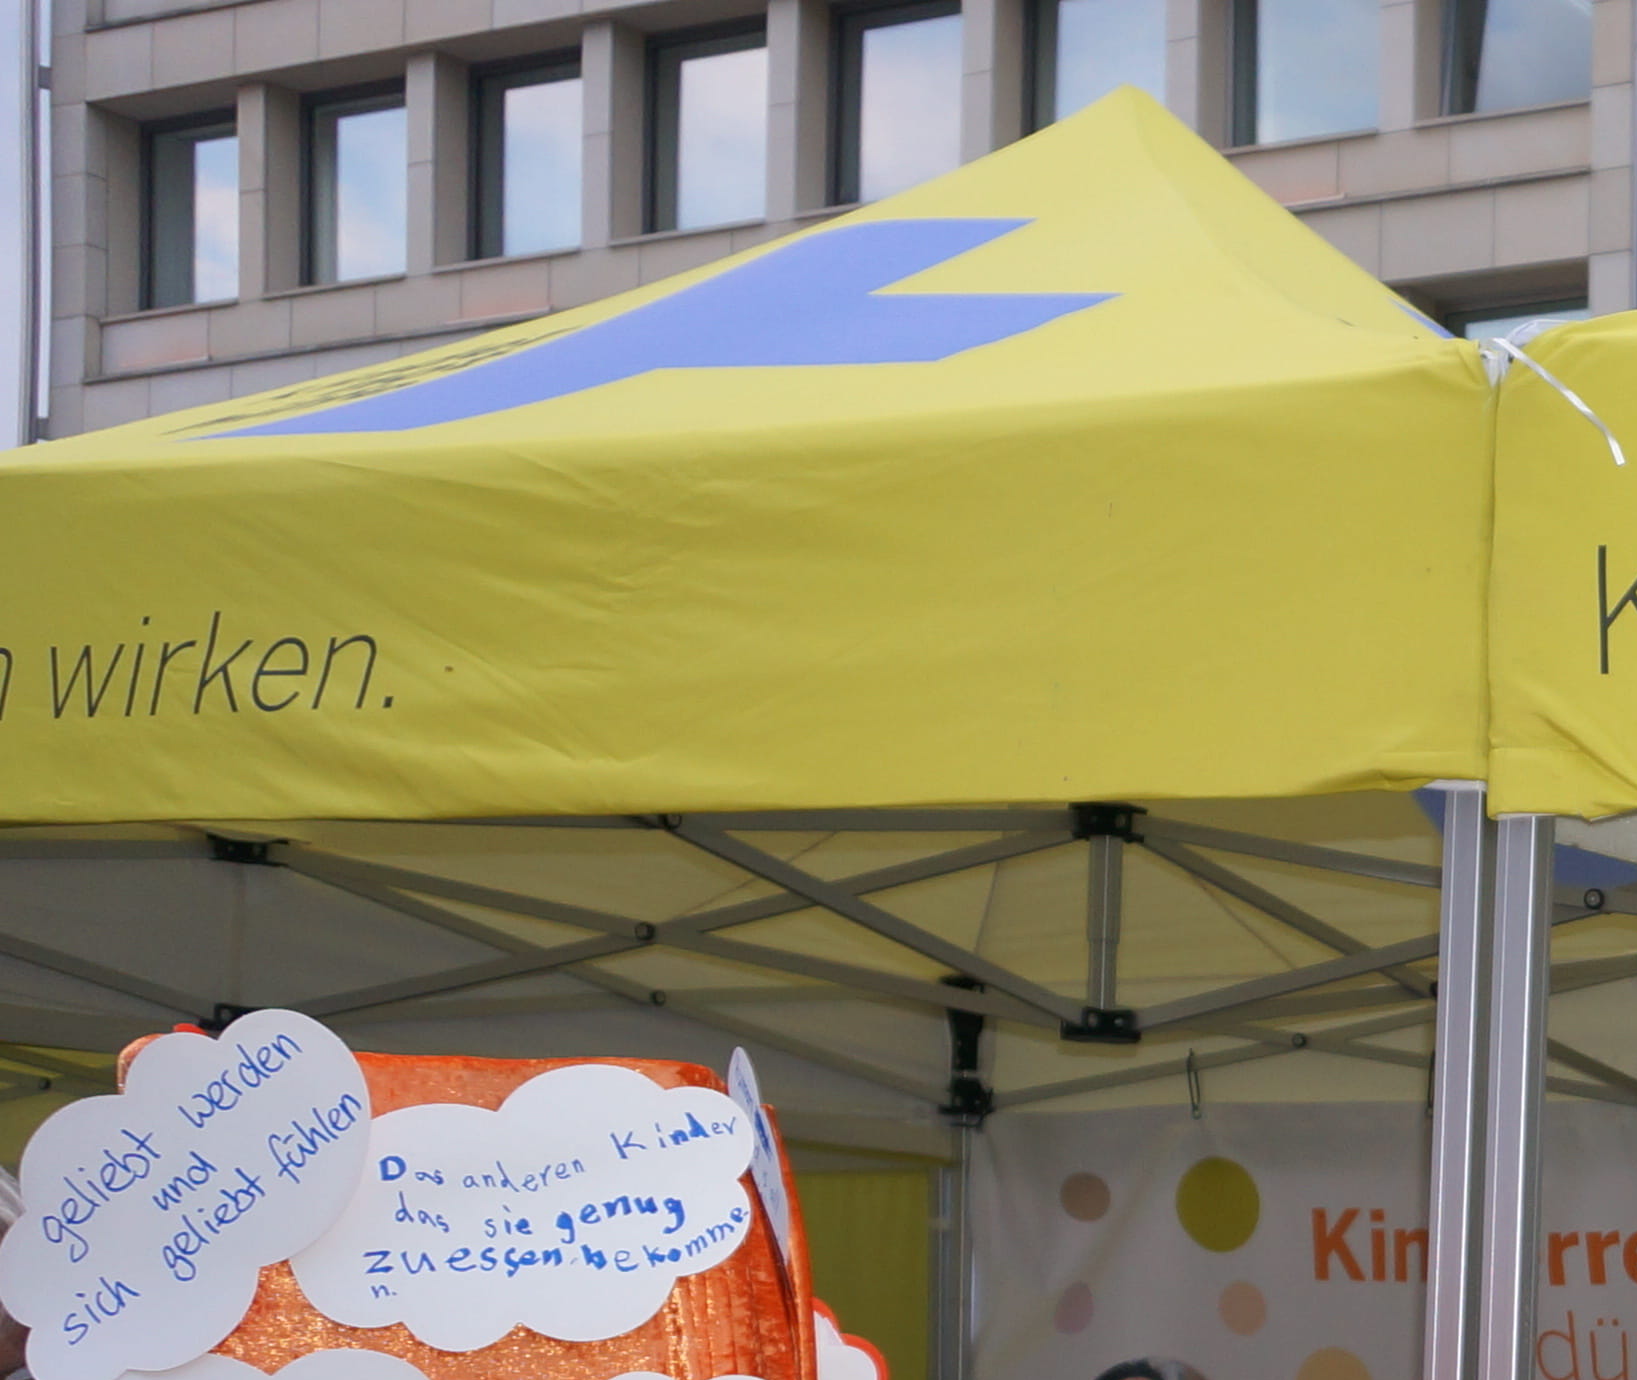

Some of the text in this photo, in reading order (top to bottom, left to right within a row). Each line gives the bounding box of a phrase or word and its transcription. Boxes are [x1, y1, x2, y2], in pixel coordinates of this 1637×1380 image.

[50, 611, 396, 720] wirken.
[43, 1032, 304, 1262] geliebt werden
[153, 1153, 215, 1217] und
[379, 1155, 445, 1185] Das
[462, 1158, 586, 1192] anderen
[63, 1094, 364, 1345] sich geliebt fühlen
[395, 1191, 685, 1244] das sie genug
